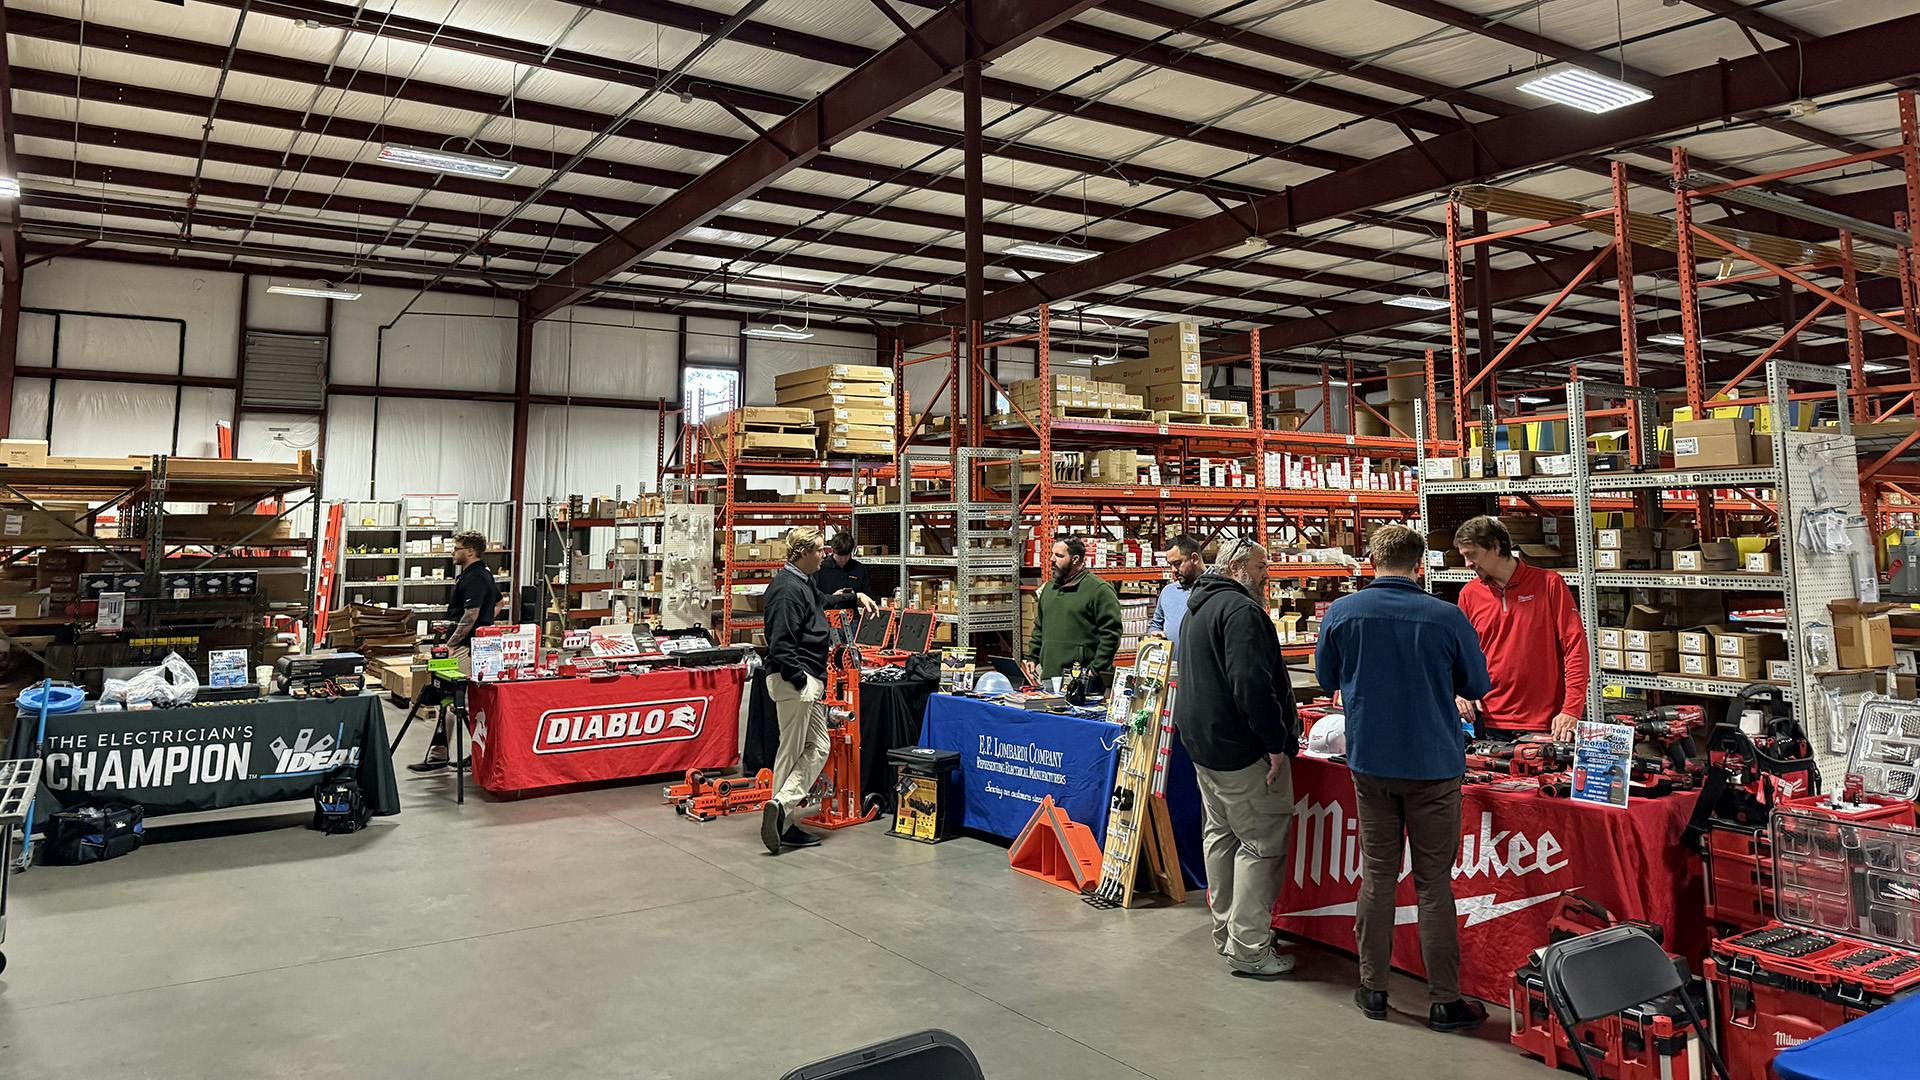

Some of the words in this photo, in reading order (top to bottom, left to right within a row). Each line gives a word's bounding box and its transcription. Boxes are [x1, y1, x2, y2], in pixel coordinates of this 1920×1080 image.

[49, 735, 88, 749] THE
[97, 726, 253, 747] ELECTRICIAN'S
[546, 709, 665, 744] DIABLO
[45, 741, 252, 792] CHAMPION
[275, 746, 360, 774] IDEAL
